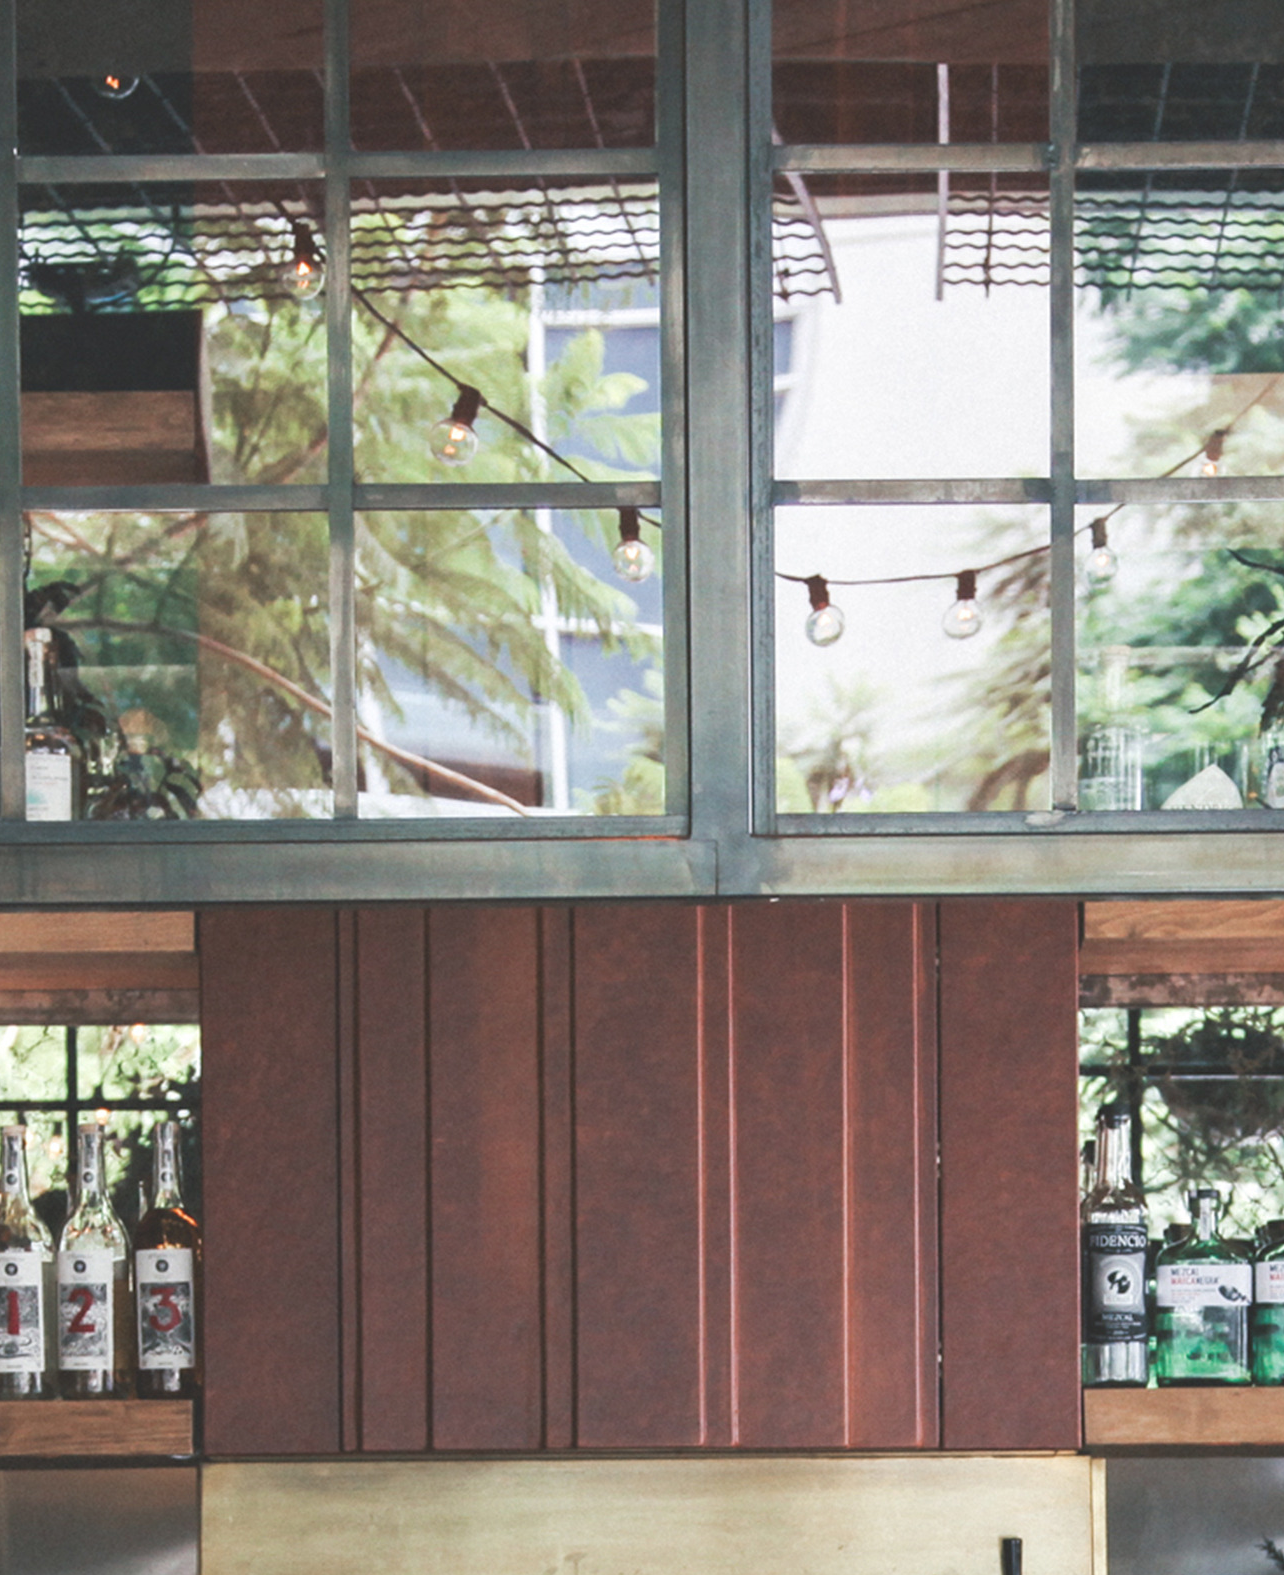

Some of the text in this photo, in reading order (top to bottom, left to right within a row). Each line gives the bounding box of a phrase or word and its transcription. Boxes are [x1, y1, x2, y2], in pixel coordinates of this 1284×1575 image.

[1089, 1234, 1147, 1248] FIDENCIO
[6, 1290, 21, 1336] 1
[68, 1288, 95, 1333] 2
[148, 1287, 183, 1332] 3
